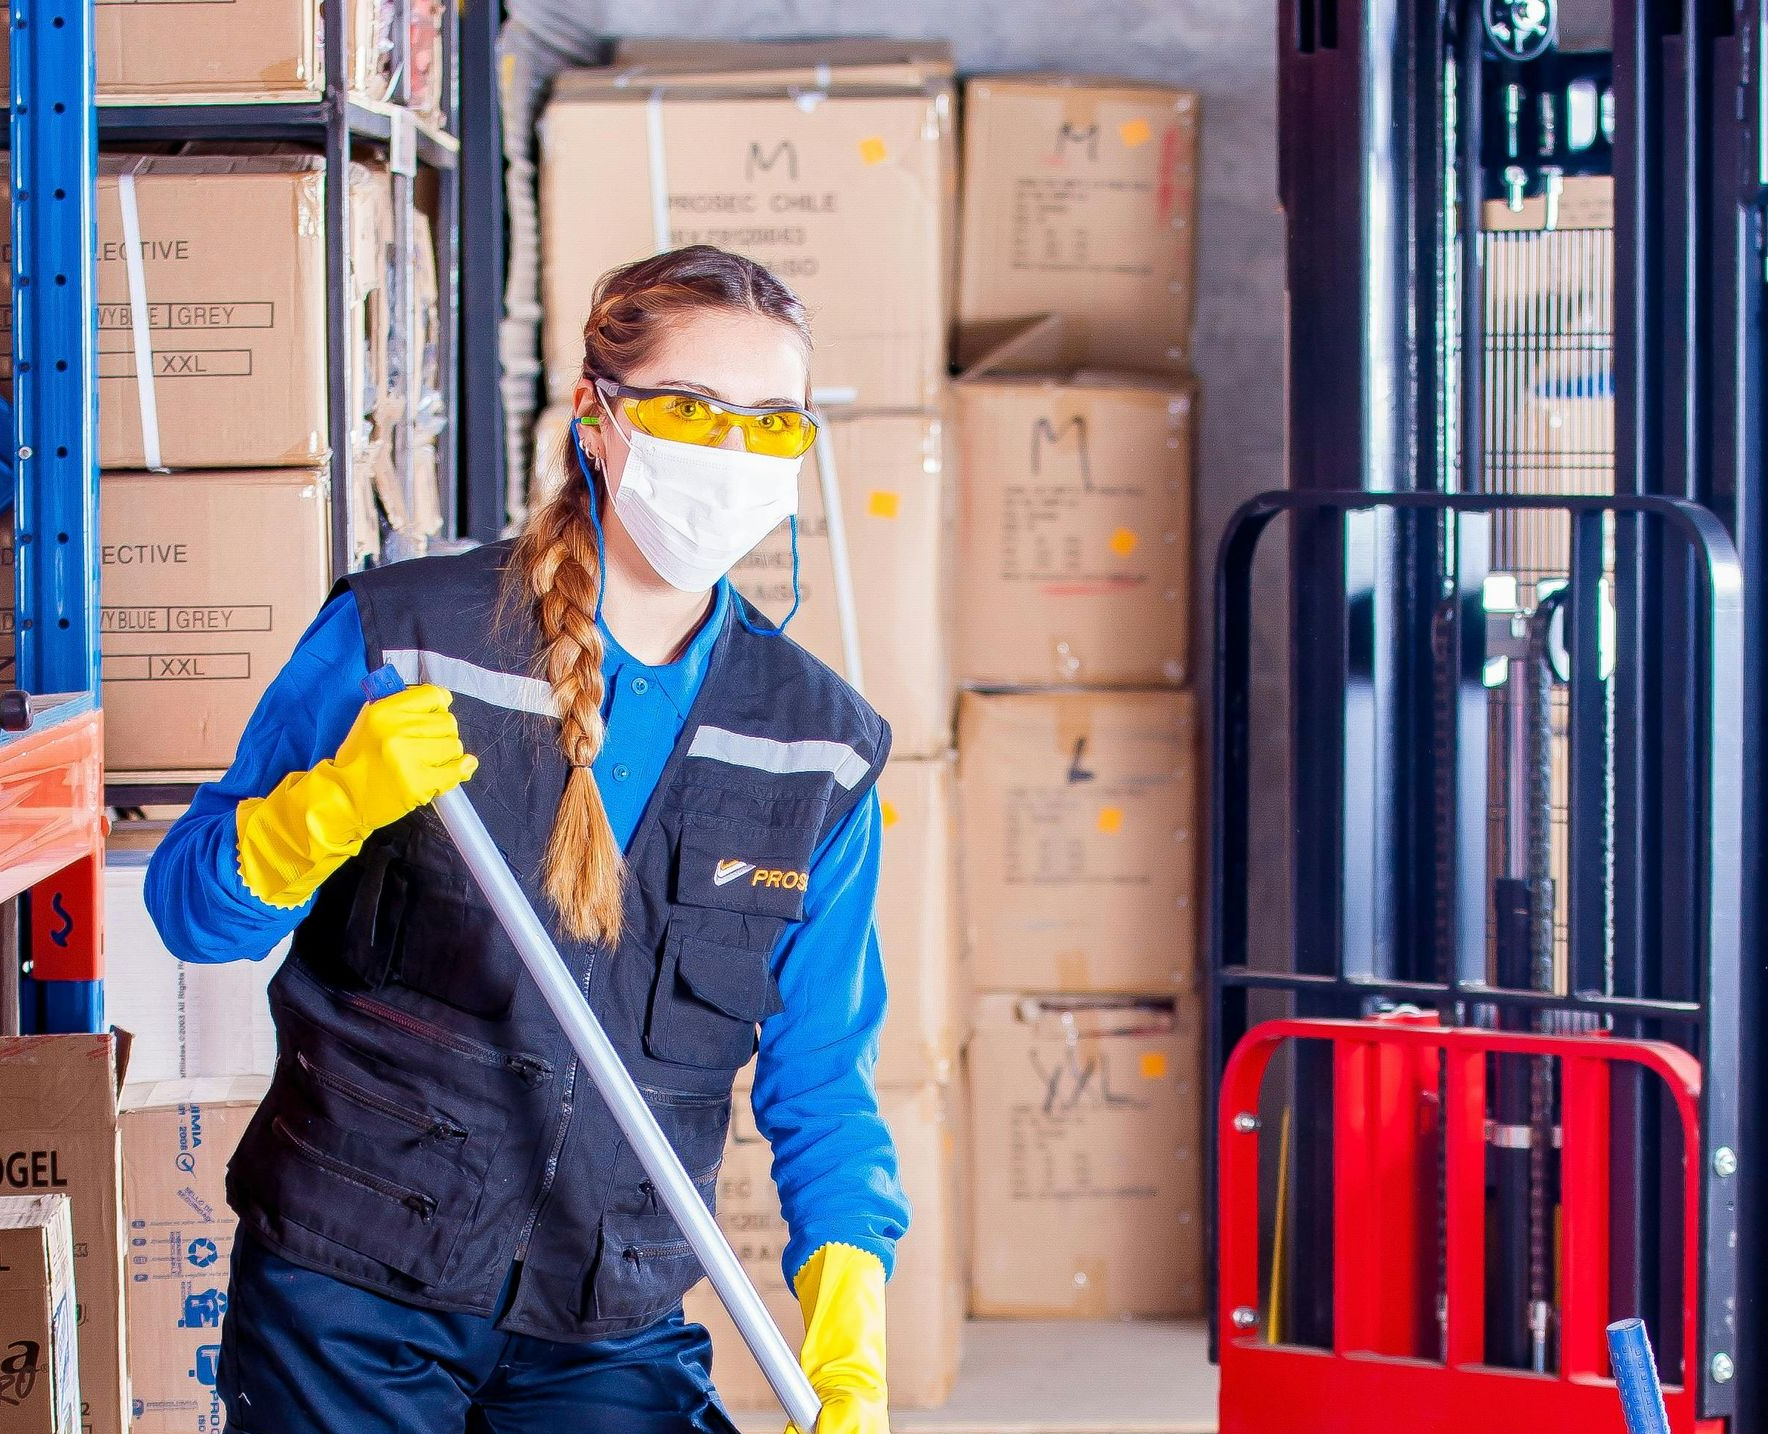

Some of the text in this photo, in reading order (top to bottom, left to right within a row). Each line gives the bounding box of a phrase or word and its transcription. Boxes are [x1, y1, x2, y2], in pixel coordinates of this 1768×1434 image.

[745, 141, 798, 181] M
[177, 306, 235, 326] GREY
[162, 355, 207, 373] XXL
[1031, 416, 1093, 492] M
[101, 544, 188, 565] ECTIVE
[176, 609, 234, 629] GREY
[159, 658, 205, 676] XXL
